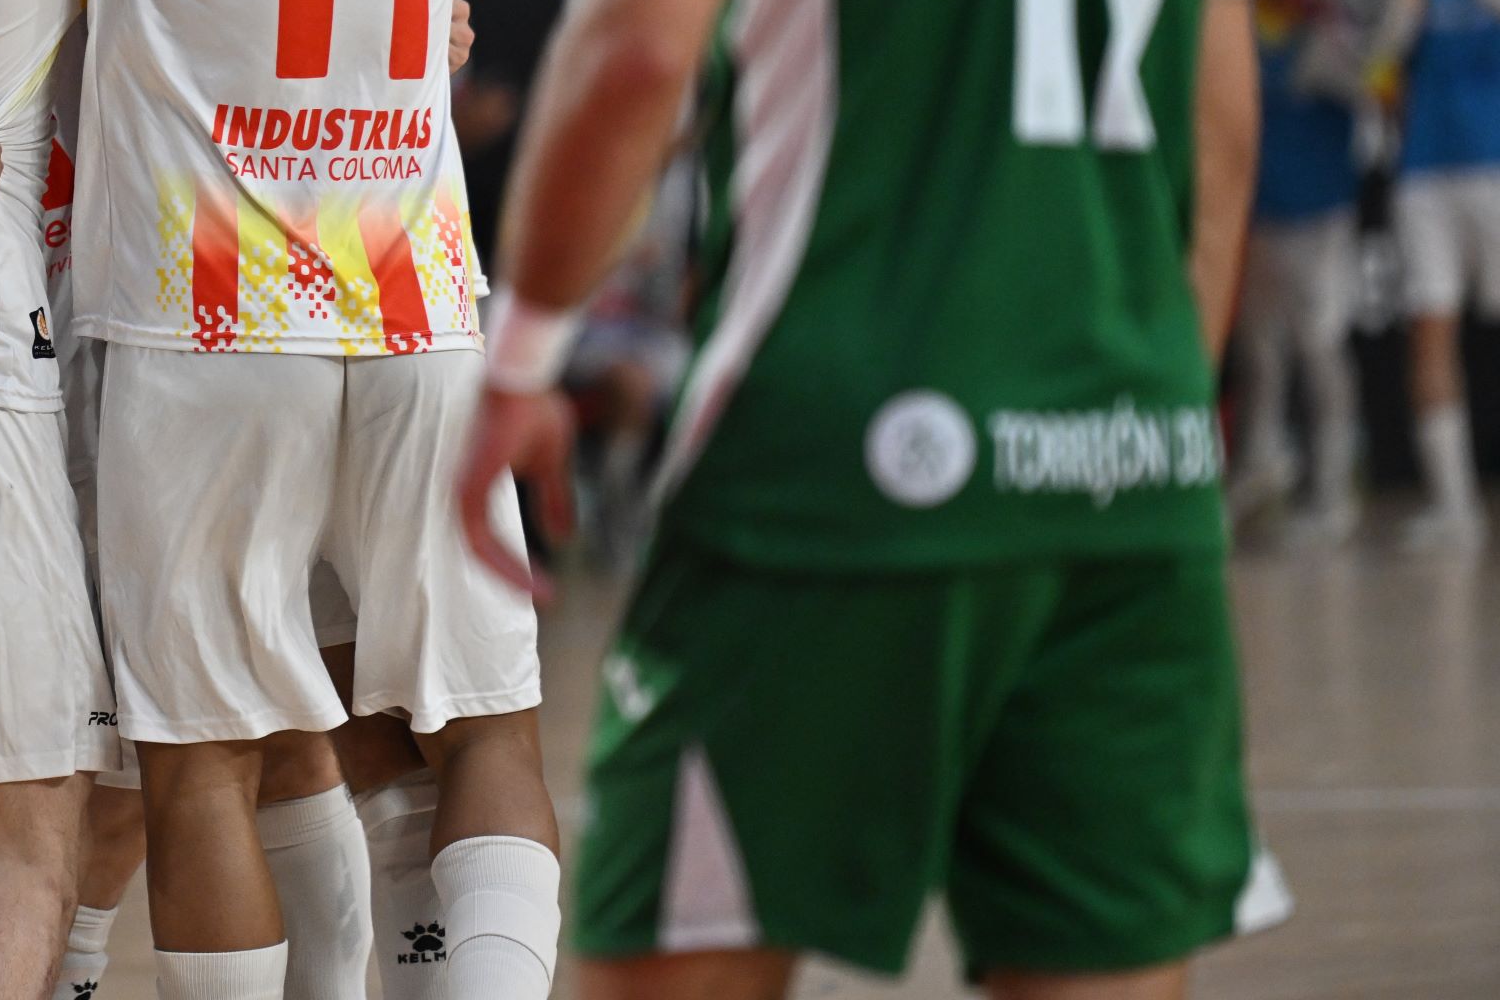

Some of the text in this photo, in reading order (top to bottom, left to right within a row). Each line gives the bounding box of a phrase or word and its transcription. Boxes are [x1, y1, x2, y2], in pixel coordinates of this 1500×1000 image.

[211, 103, 432, 151] INDUSTRIAS
[226, 152, 422, 182] SANTA COLOMA
